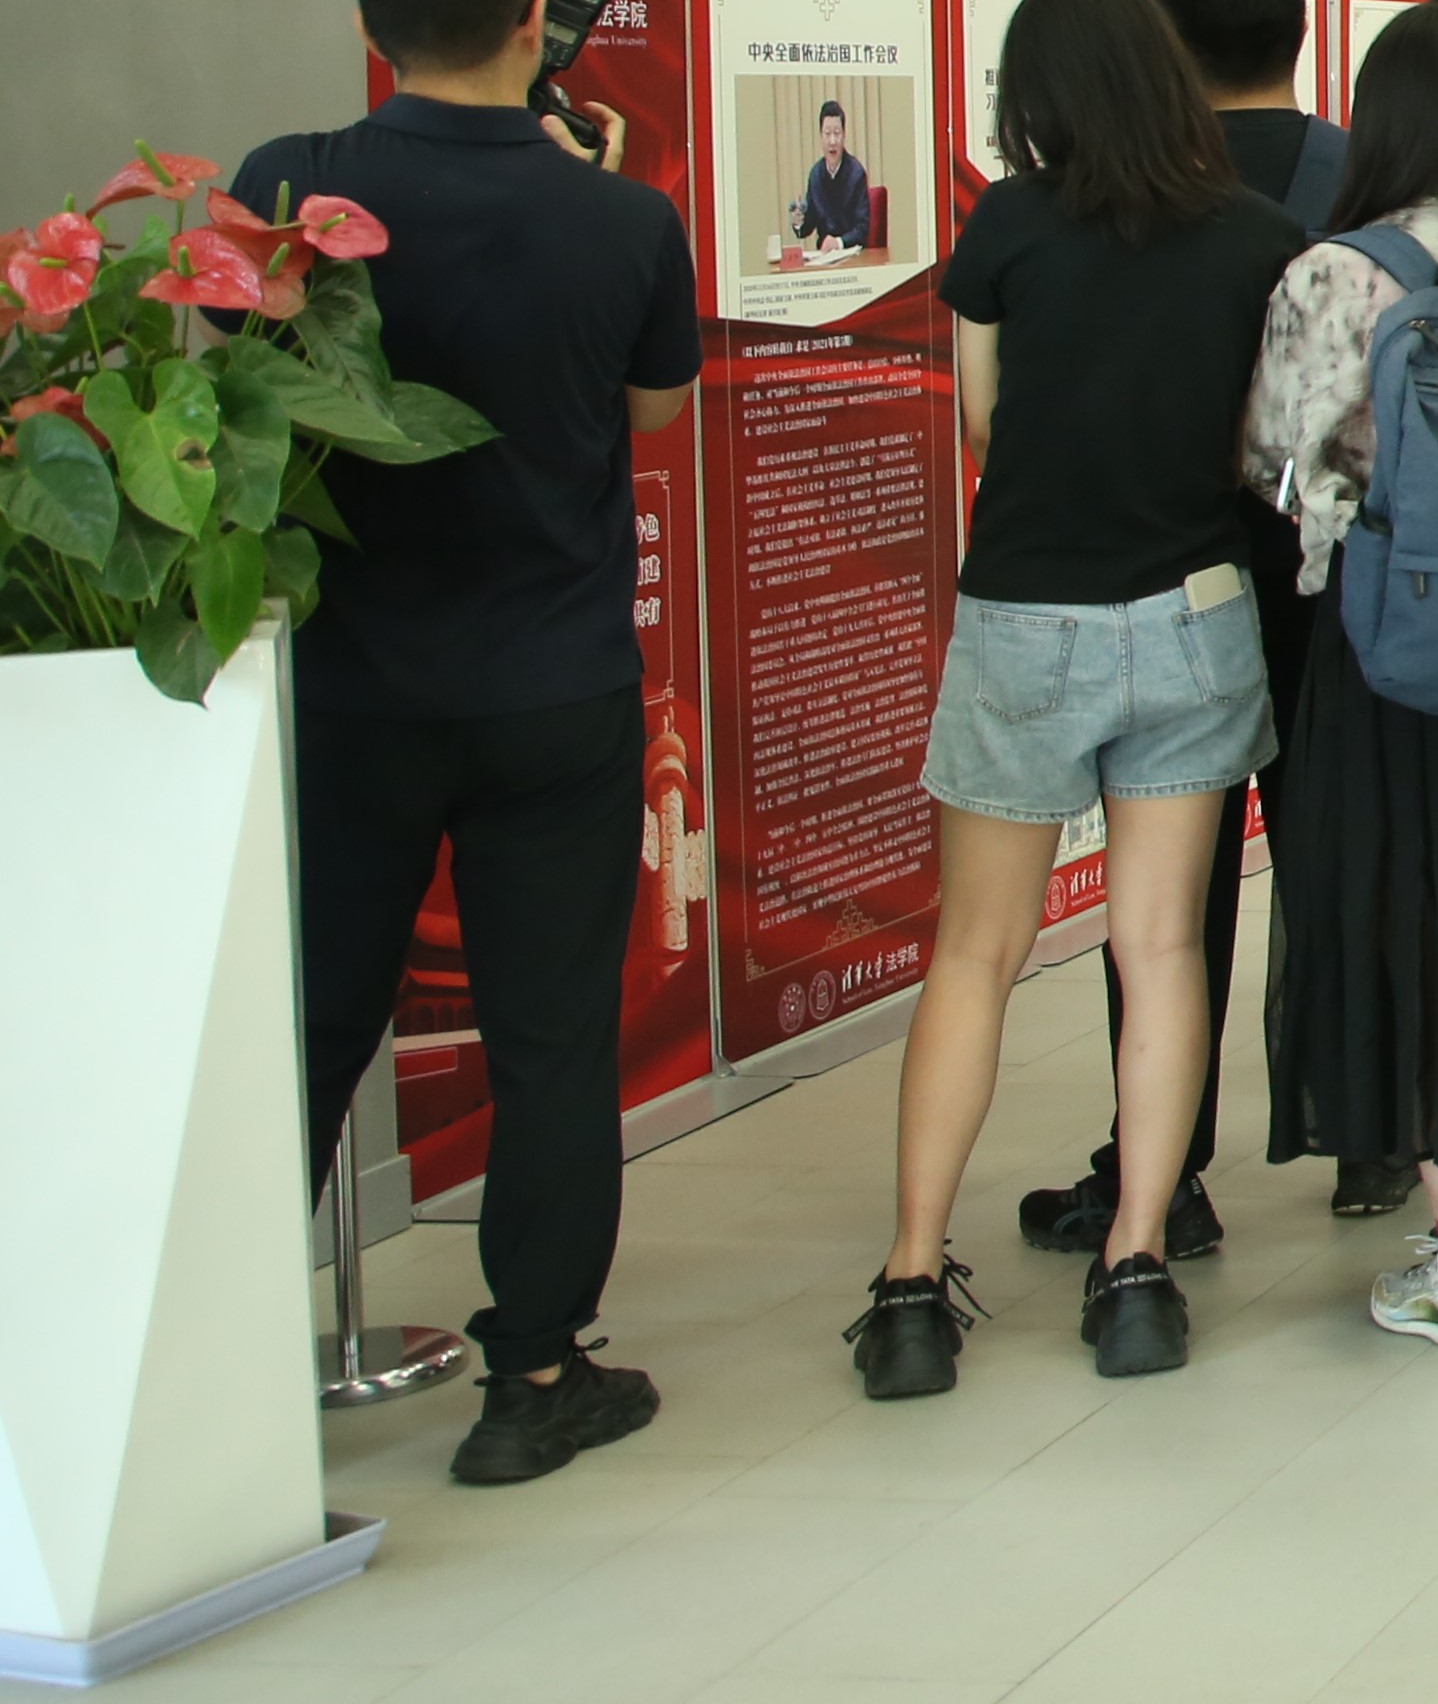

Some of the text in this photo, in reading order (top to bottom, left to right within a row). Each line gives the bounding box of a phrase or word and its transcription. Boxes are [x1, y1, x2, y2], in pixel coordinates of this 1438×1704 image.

[748, 42, 899, 64] 中央全面依法治国工作会议
